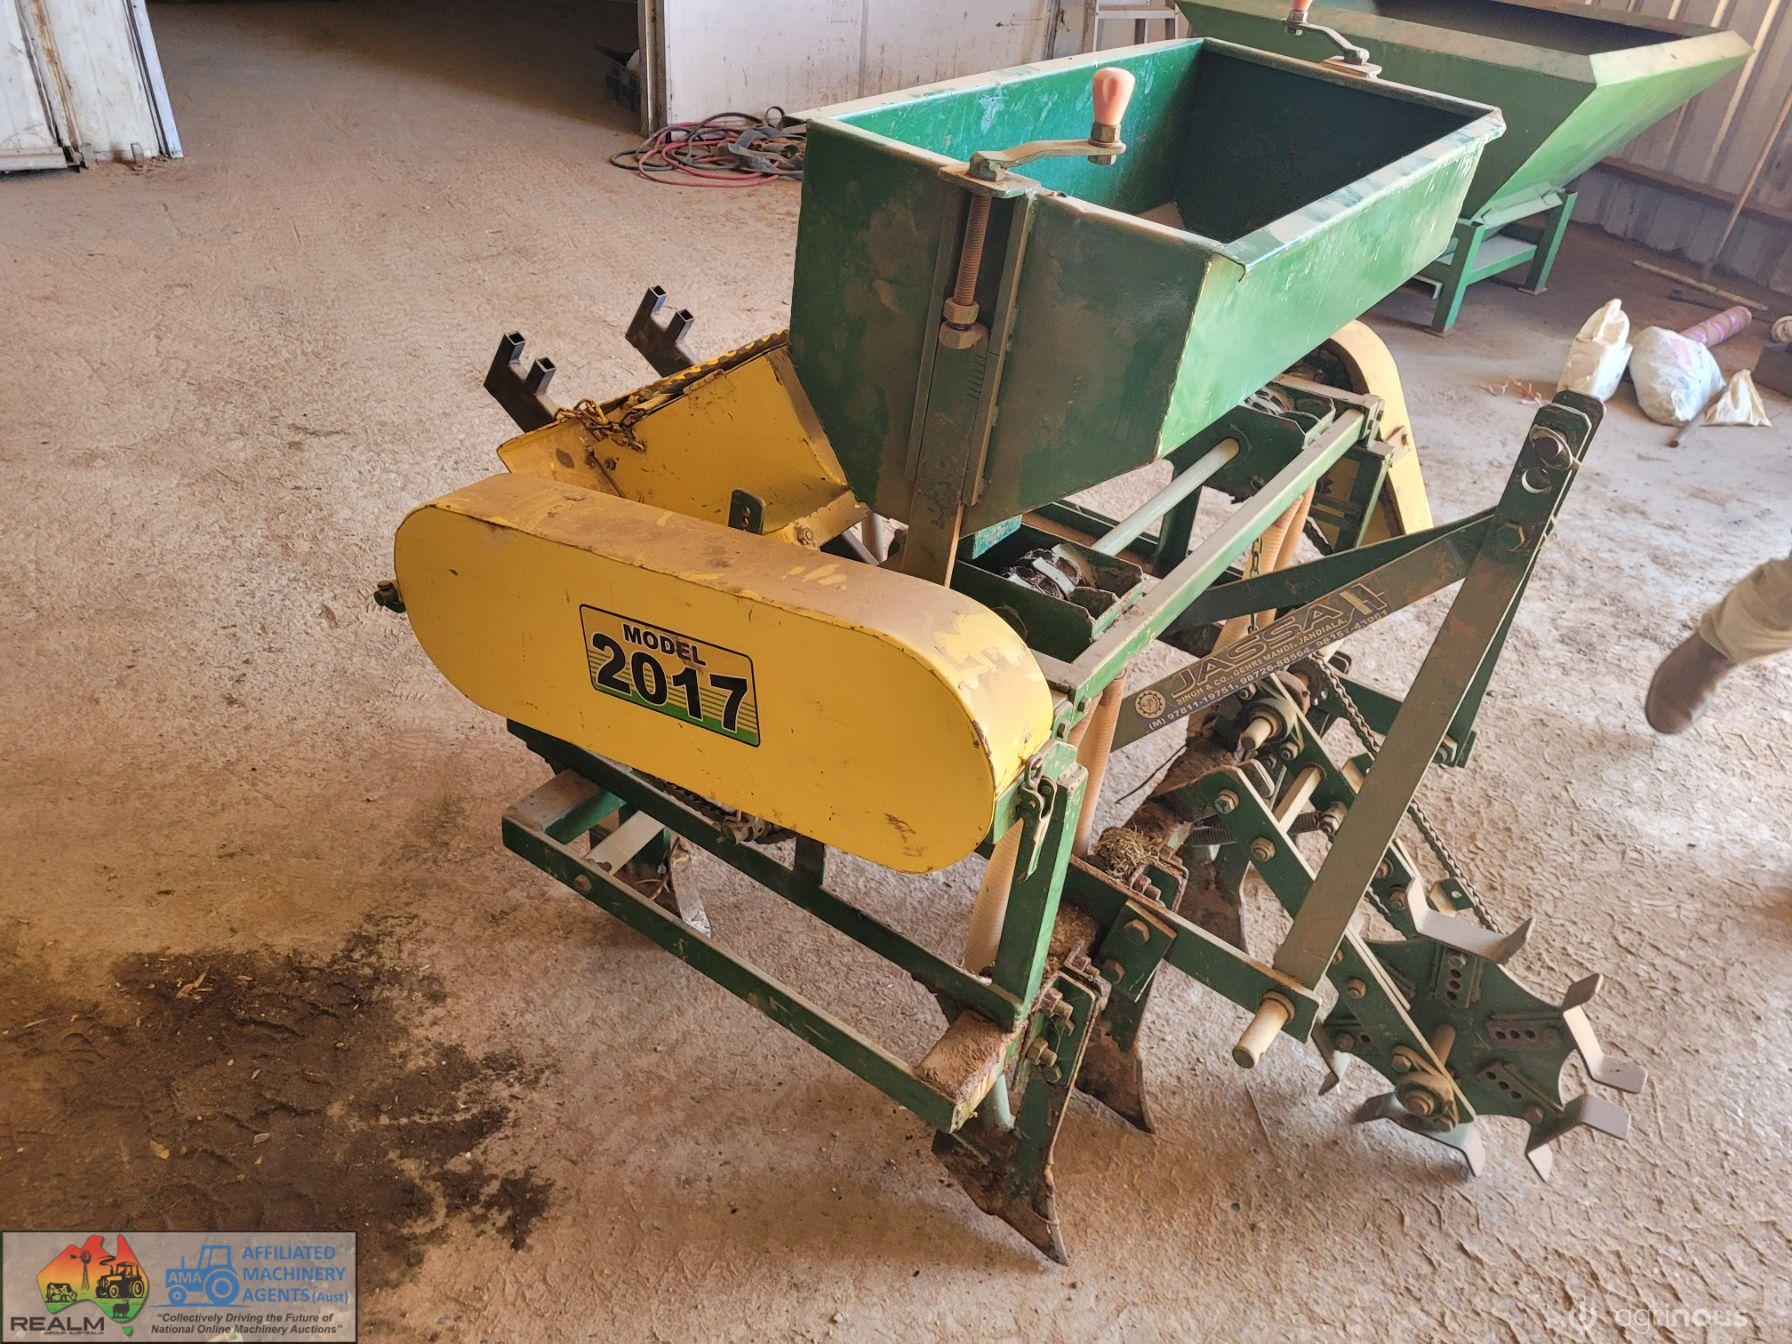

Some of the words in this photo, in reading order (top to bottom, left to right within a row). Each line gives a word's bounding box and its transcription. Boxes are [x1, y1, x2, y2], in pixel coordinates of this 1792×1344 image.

[622, 623, 707, 666] MODEL
[1169, 601, 1345, 698] JASSA
[591, 633, 748, 732] 2017
[1176, 685, 1204, 706] SINGH
[1205, 680, 1213, 691] &
[1148, 716, 1167, 732] (M)
